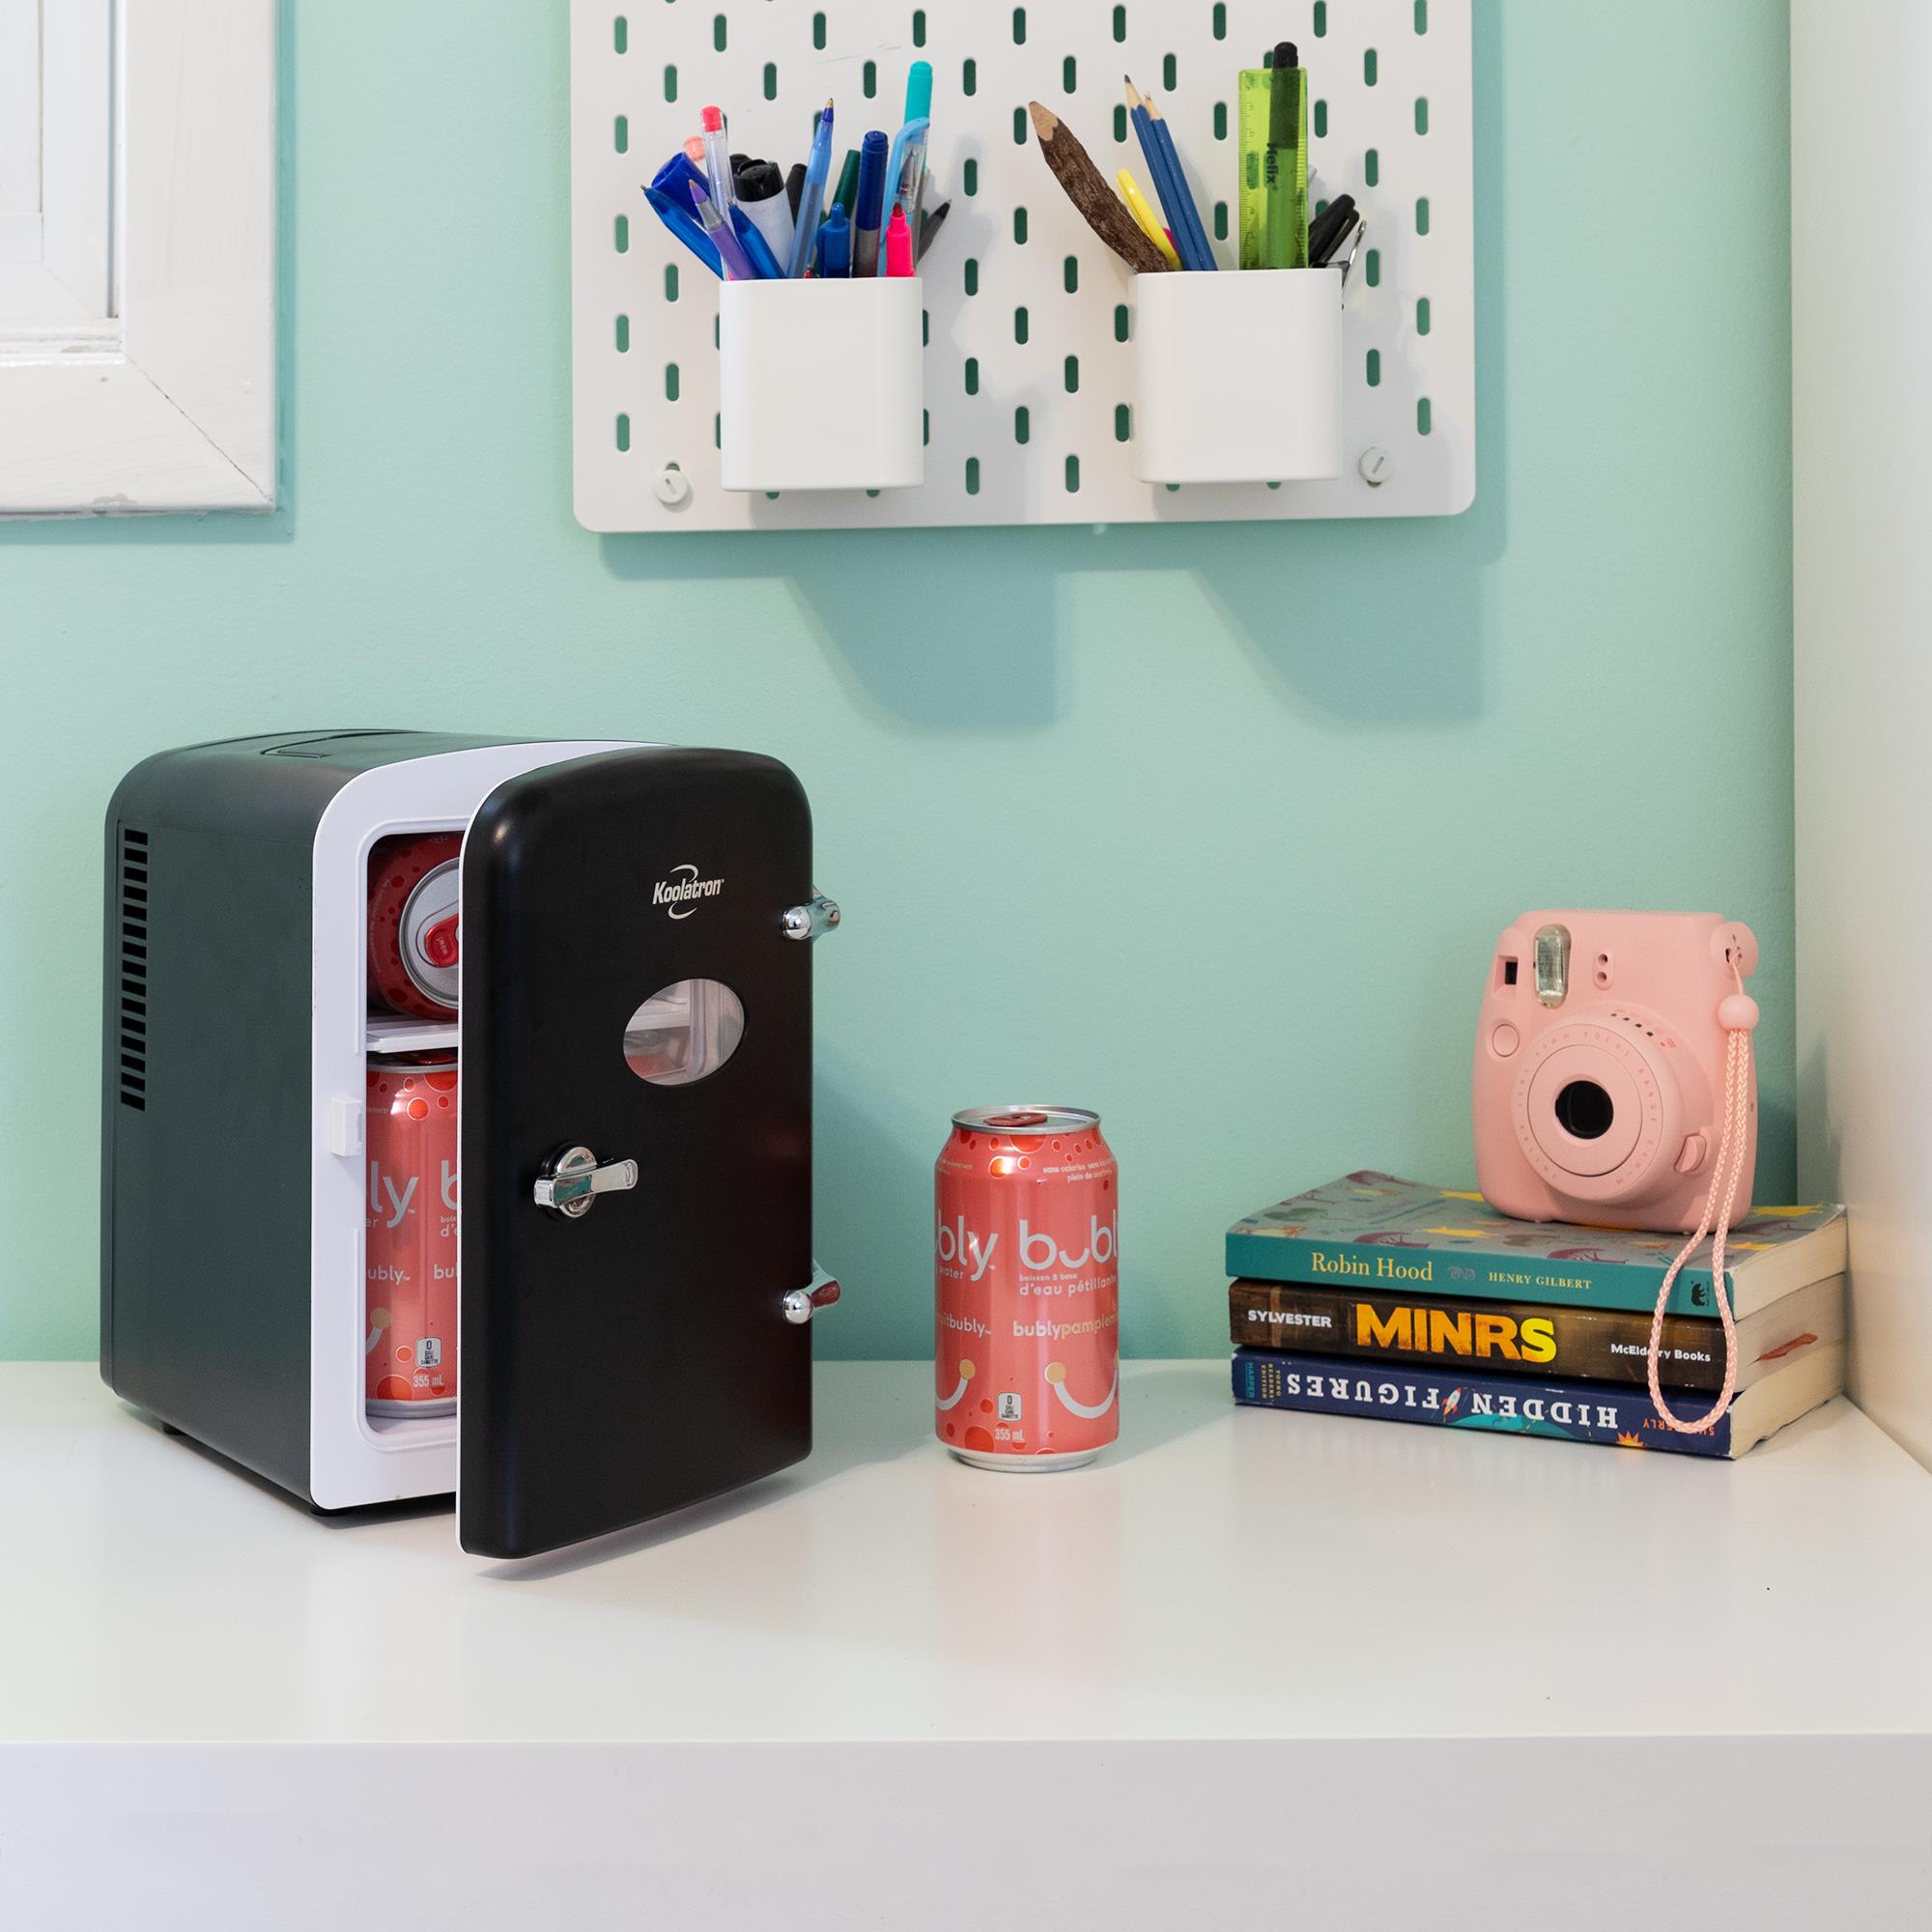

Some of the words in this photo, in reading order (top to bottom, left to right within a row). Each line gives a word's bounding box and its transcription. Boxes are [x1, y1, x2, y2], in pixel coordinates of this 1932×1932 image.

[1266, 143, 1279, 185] Helix
[652, 877, 722, 905] Koolatron
[1311, 1252, 1371, 1276] Robin
[1376, 1258, 1434, 1281] Hood
[1019, 1273, 1050, 1282] boisson
[1489, 1271, 1532, 1286] HENRY
[1536, 1275, 1593, 1290] GILBERT
[1019, 1282, 1062, 1295] d'eau
[1247, 1309, 1332, 1328] SYLVESTER
[1355, 1303, 1557, 1363] MINRS
[1610, 1343, 1671, 1359] McEldry
[1674, 1349, 1711, 1362] Books
[412, 1375, 430, 1388] 355
[432, 1375, 443, 1386] mL
[1287, 1374, 1440, 1409] FIGURES
[1470, 1392, 1618, 1429] HIDDEN
[995, 1429, 1010, 1441] 355
[1011, 1429, 1025, 1441] mL
